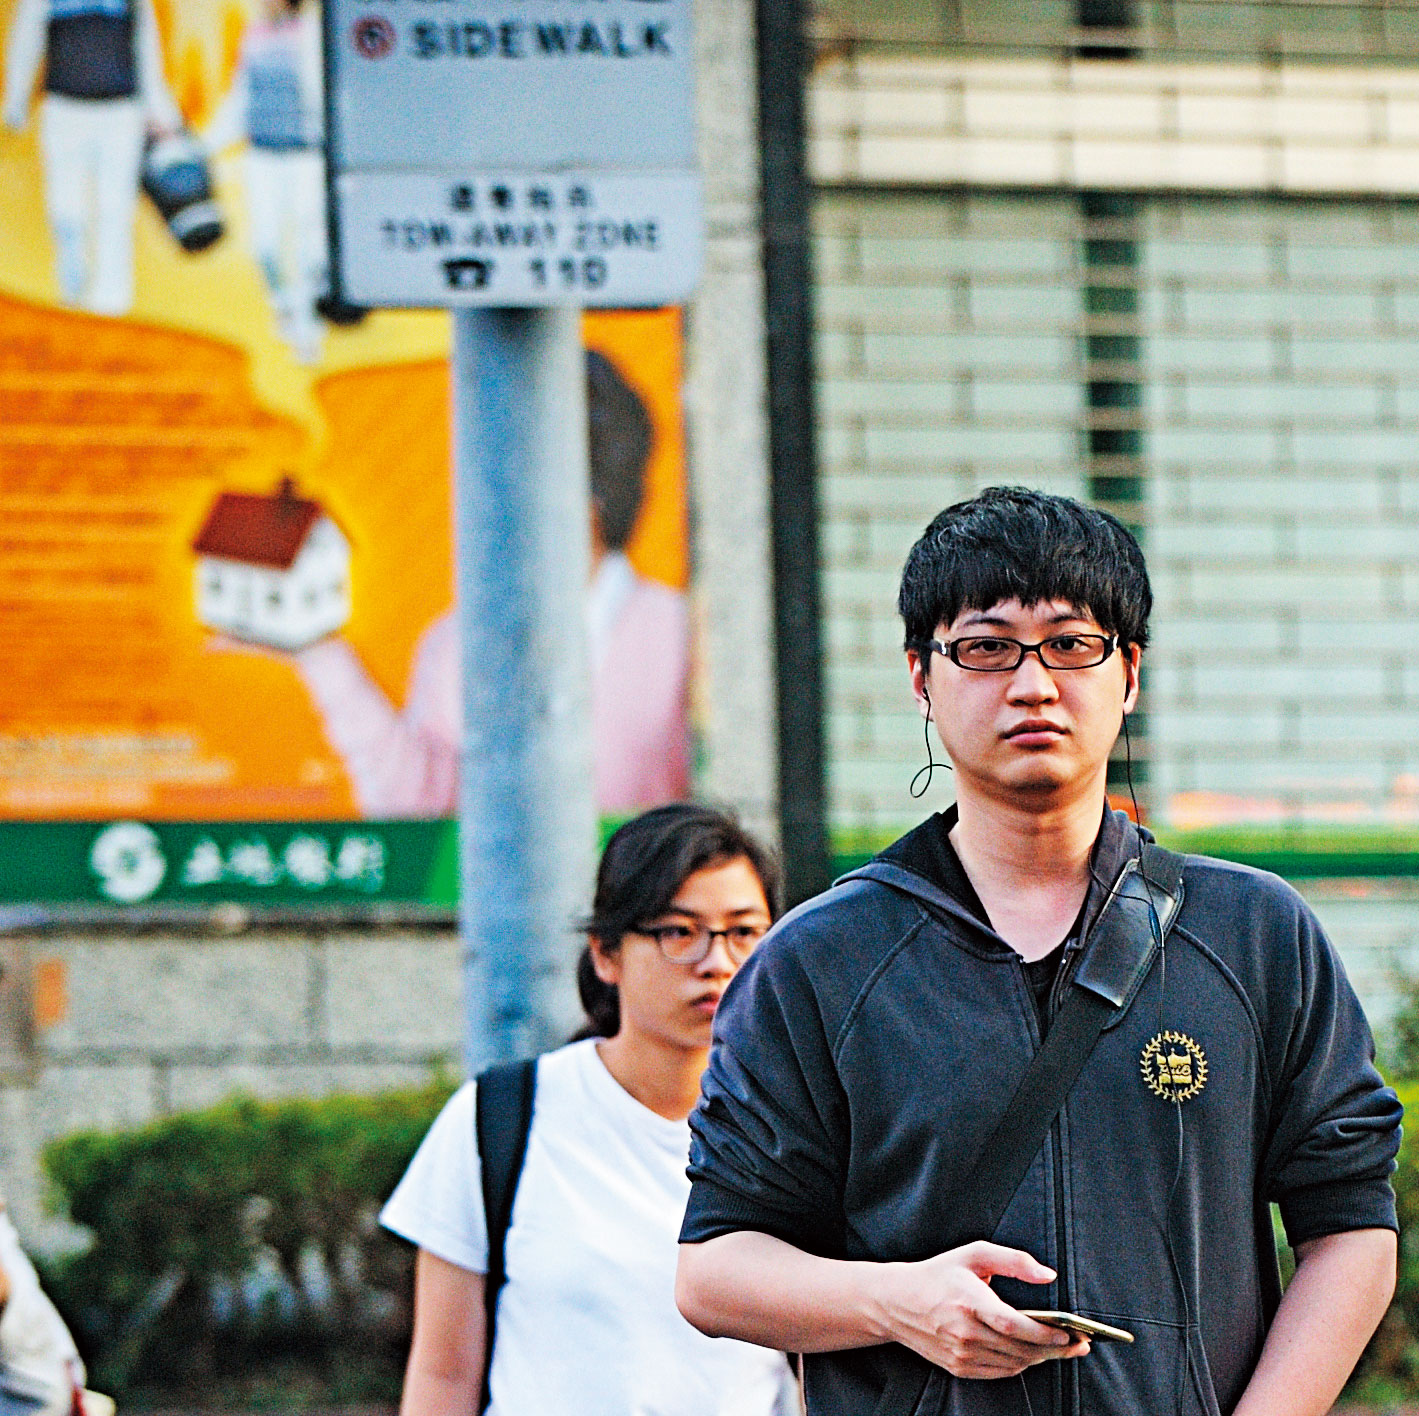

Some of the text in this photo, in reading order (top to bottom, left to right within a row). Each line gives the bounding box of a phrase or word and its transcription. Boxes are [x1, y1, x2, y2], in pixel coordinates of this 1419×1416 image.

[410, 20, 672, 59] SIDEWALK
[577, 218, 659, 251] ZONE
[529, 257, 608, 289] 110
